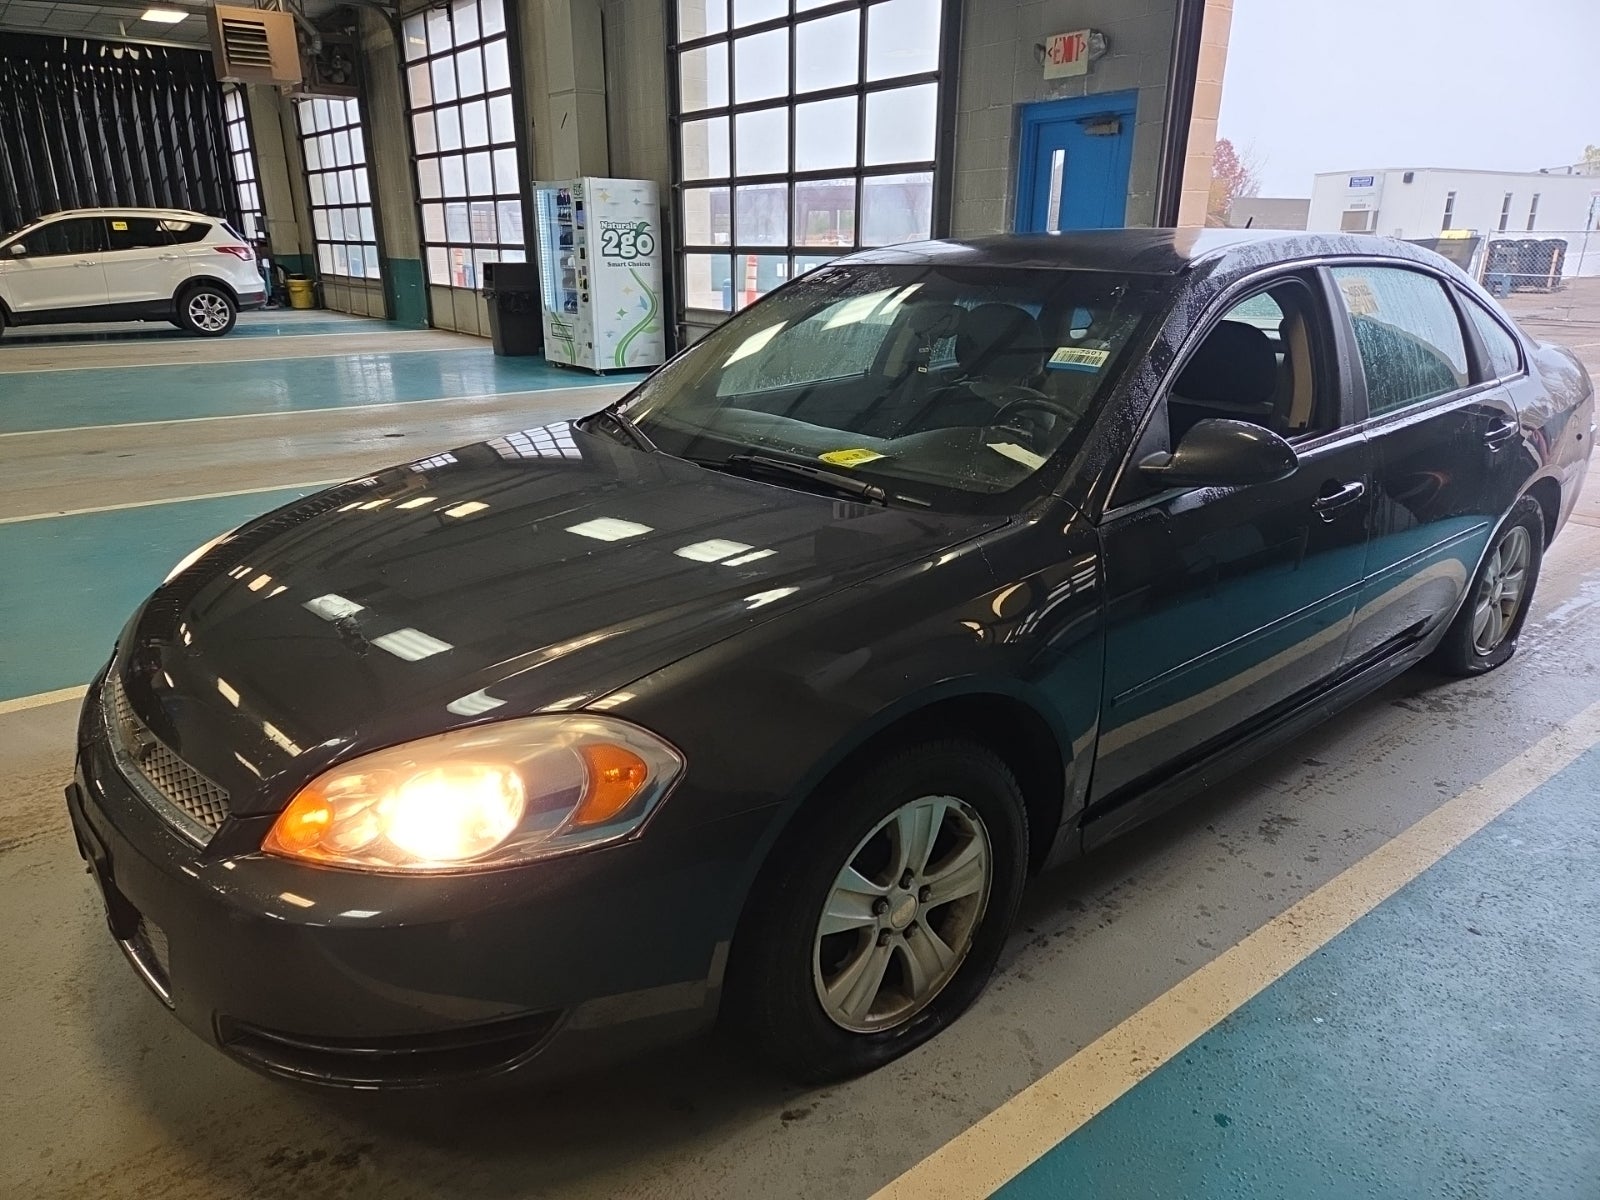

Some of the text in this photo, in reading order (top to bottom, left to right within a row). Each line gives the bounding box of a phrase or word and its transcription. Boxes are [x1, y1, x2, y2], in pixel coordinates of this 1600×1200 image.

[1053, 33, 1082, 64] EXIT
[600, 221, 637, 230] Naturals
[601, 229, 654, 259] 2go
